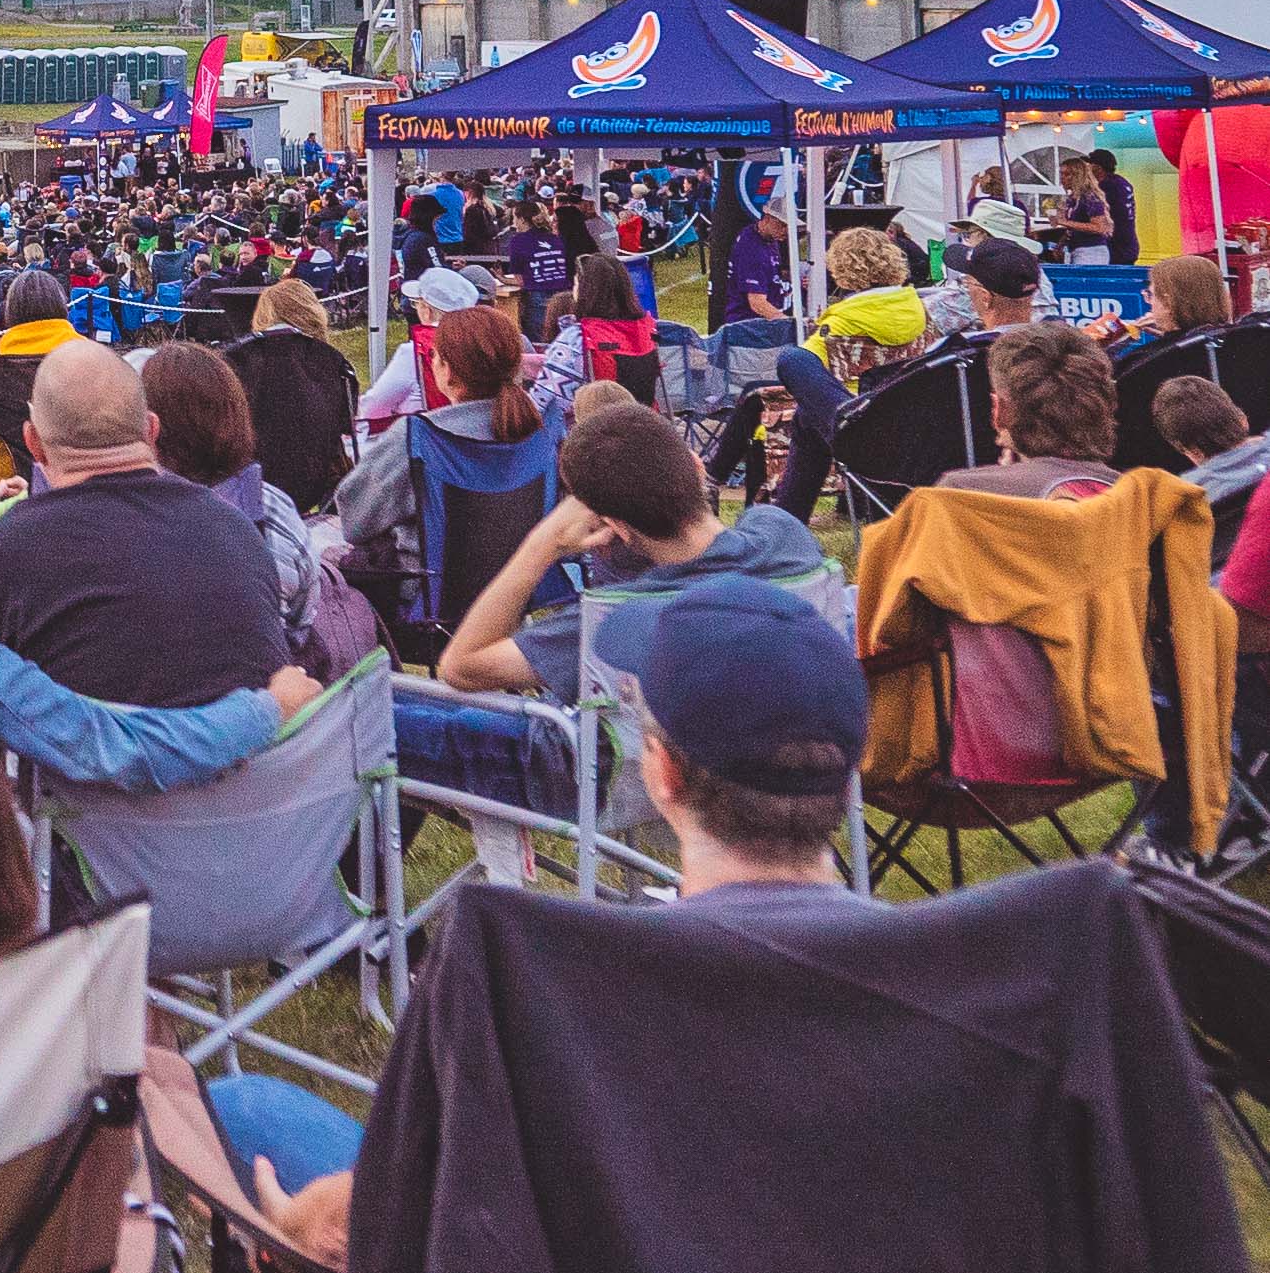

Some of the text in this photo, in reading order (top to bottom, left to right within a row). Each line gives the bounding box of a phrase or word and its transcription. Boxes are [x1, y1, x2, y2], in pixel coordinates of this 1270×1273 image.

[378, 113, 772, 141] FESTIVAL D'HUMOUR de l'Abitibi-Témiscamingue
[794, 107, 842, 139] FESTIVAL
[842, 108, 897, 136] D'HUMOUR
[1059, 297, 1123, 319] BUD
